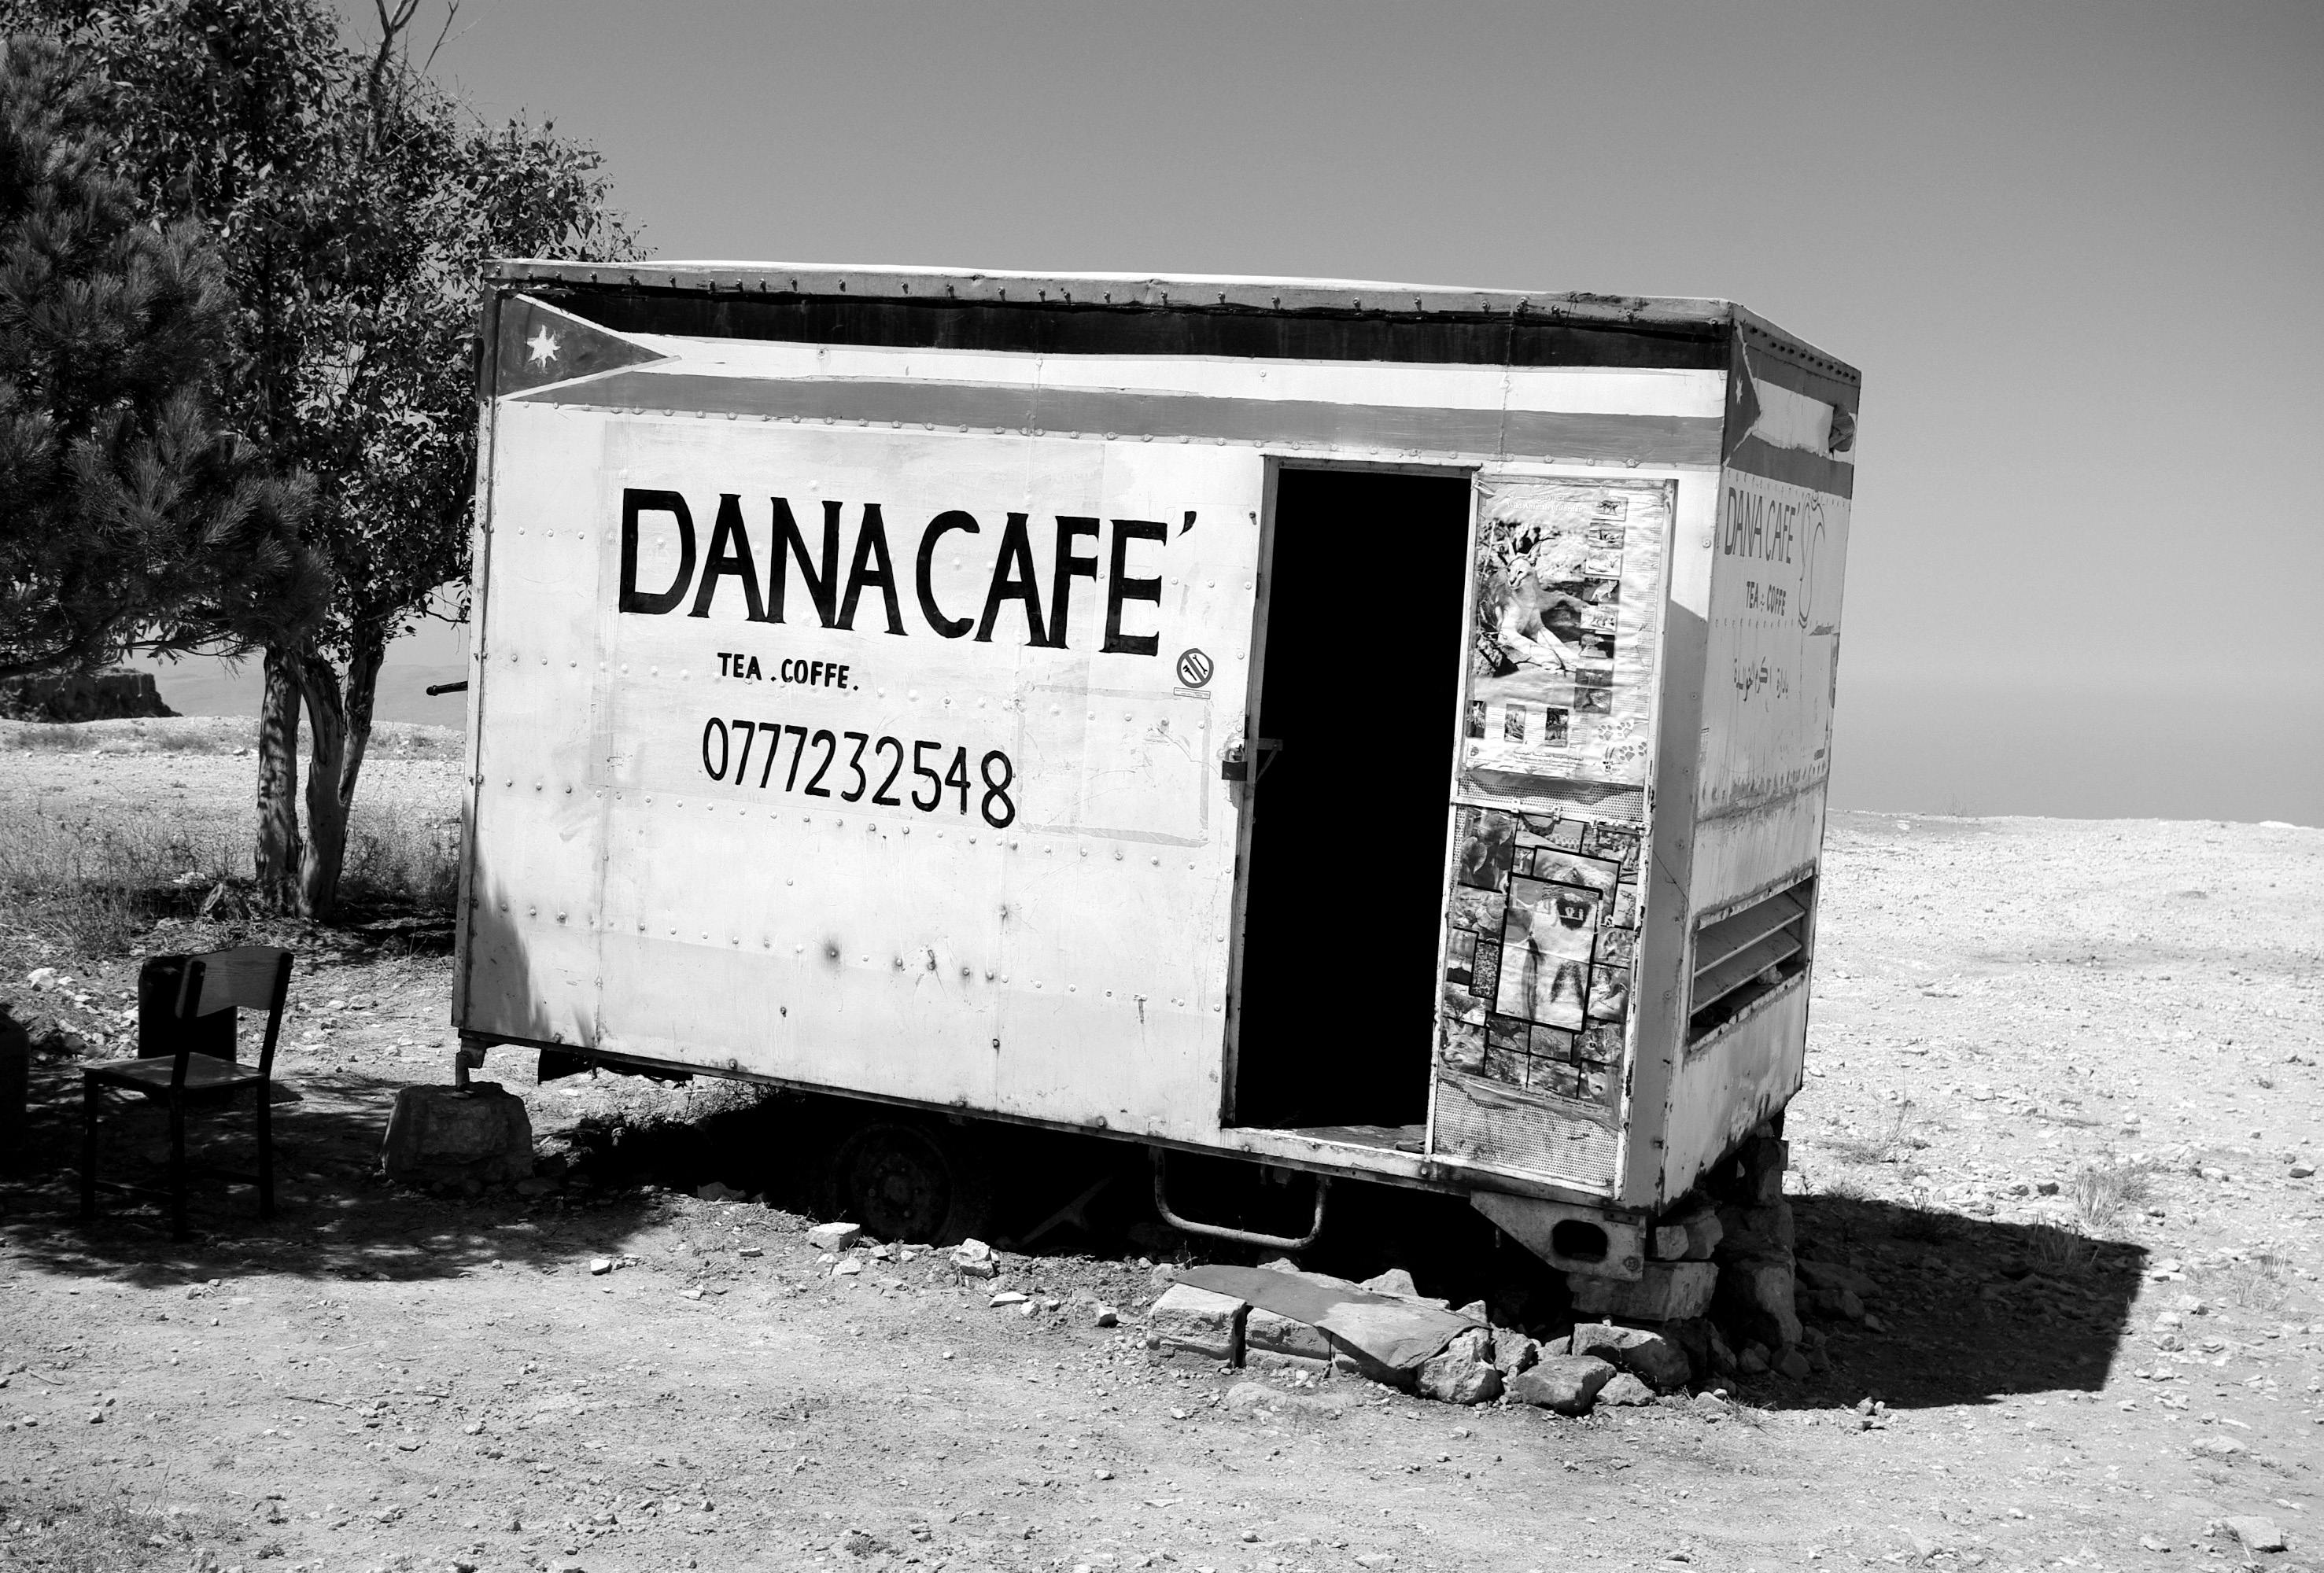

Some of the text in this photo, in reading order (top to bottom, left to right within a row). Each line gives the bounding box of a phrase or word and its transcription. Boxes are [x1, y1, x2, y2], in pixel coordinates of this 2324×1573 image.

[1725, 487, 1762, 558] DANA
[619, 488, 908, 636] DANA
[1746, 581, 1758, 609] TEA
[717, 653, 762, 681] TEA
[703, 717, 1016, 828] 0777232548
